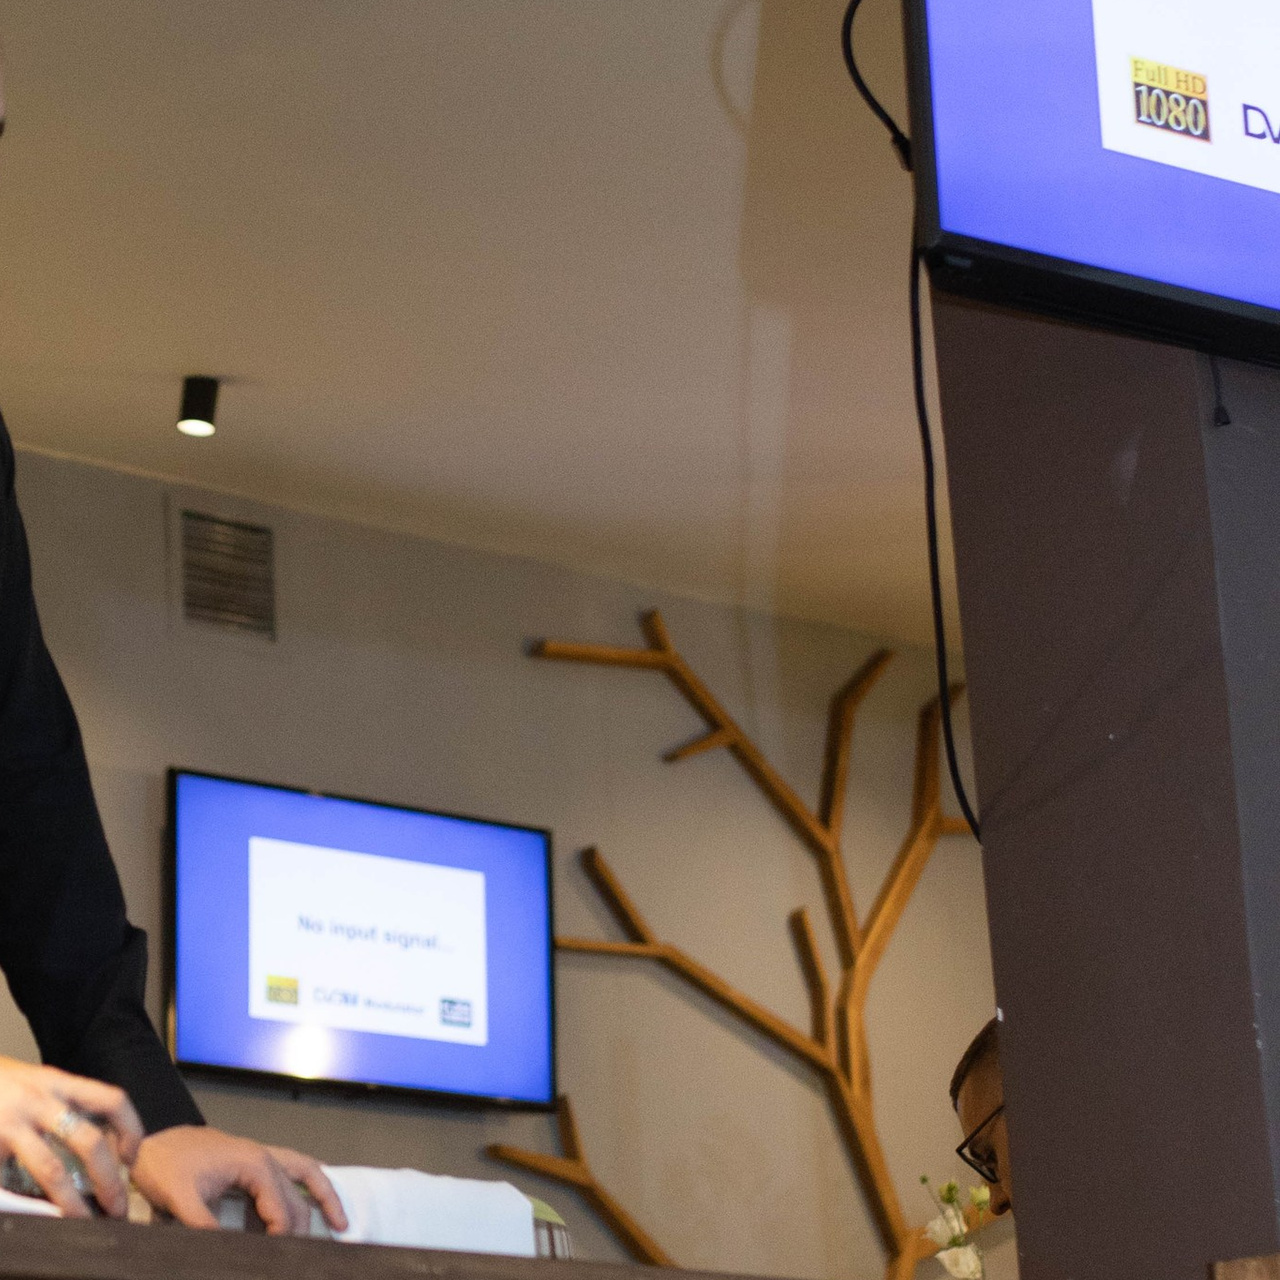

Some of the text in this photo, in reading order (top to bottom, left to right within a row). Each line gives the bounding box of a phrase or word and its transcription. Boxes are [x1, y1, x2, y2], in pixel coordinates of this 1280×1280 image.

[1132, 59, 1207, 95] Full HD
[1134, 84, 1207, 136] 1080
[297, 915, 323, 933] No
[330, 920, 377, 941] input
